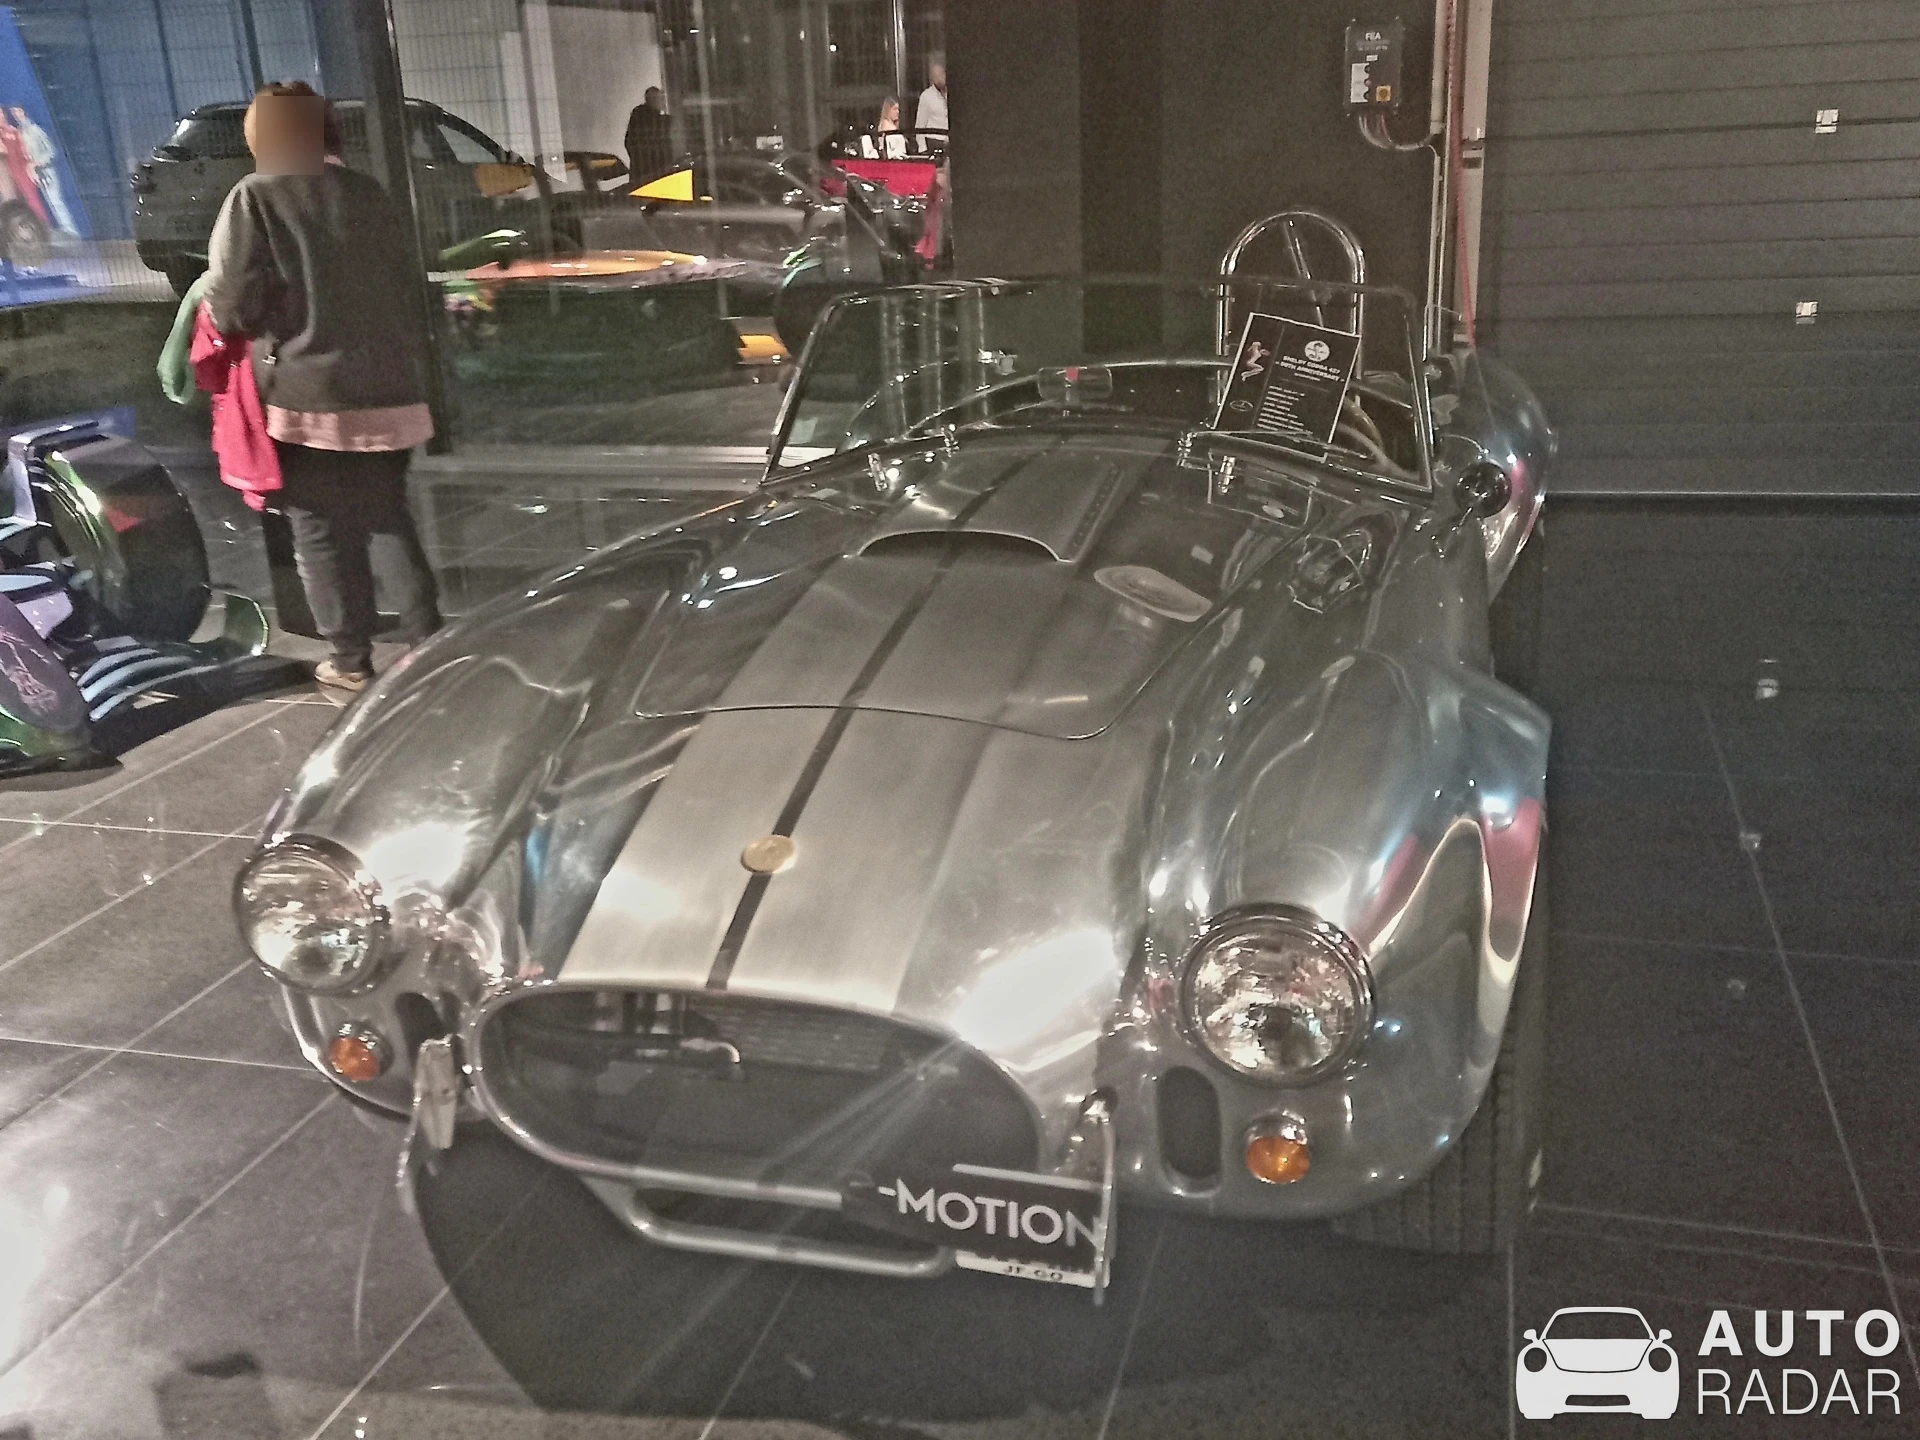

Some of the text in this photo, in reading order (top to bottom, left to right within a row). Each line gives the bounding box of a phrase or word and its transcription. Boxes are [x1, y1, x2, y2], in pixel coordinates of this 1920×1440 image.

[1283, 356, 1307, 365] SHELBY
[1307, 361, 1328, 371] COBRA
[1296, 366, 1340, 382] ANNIVERSARY
